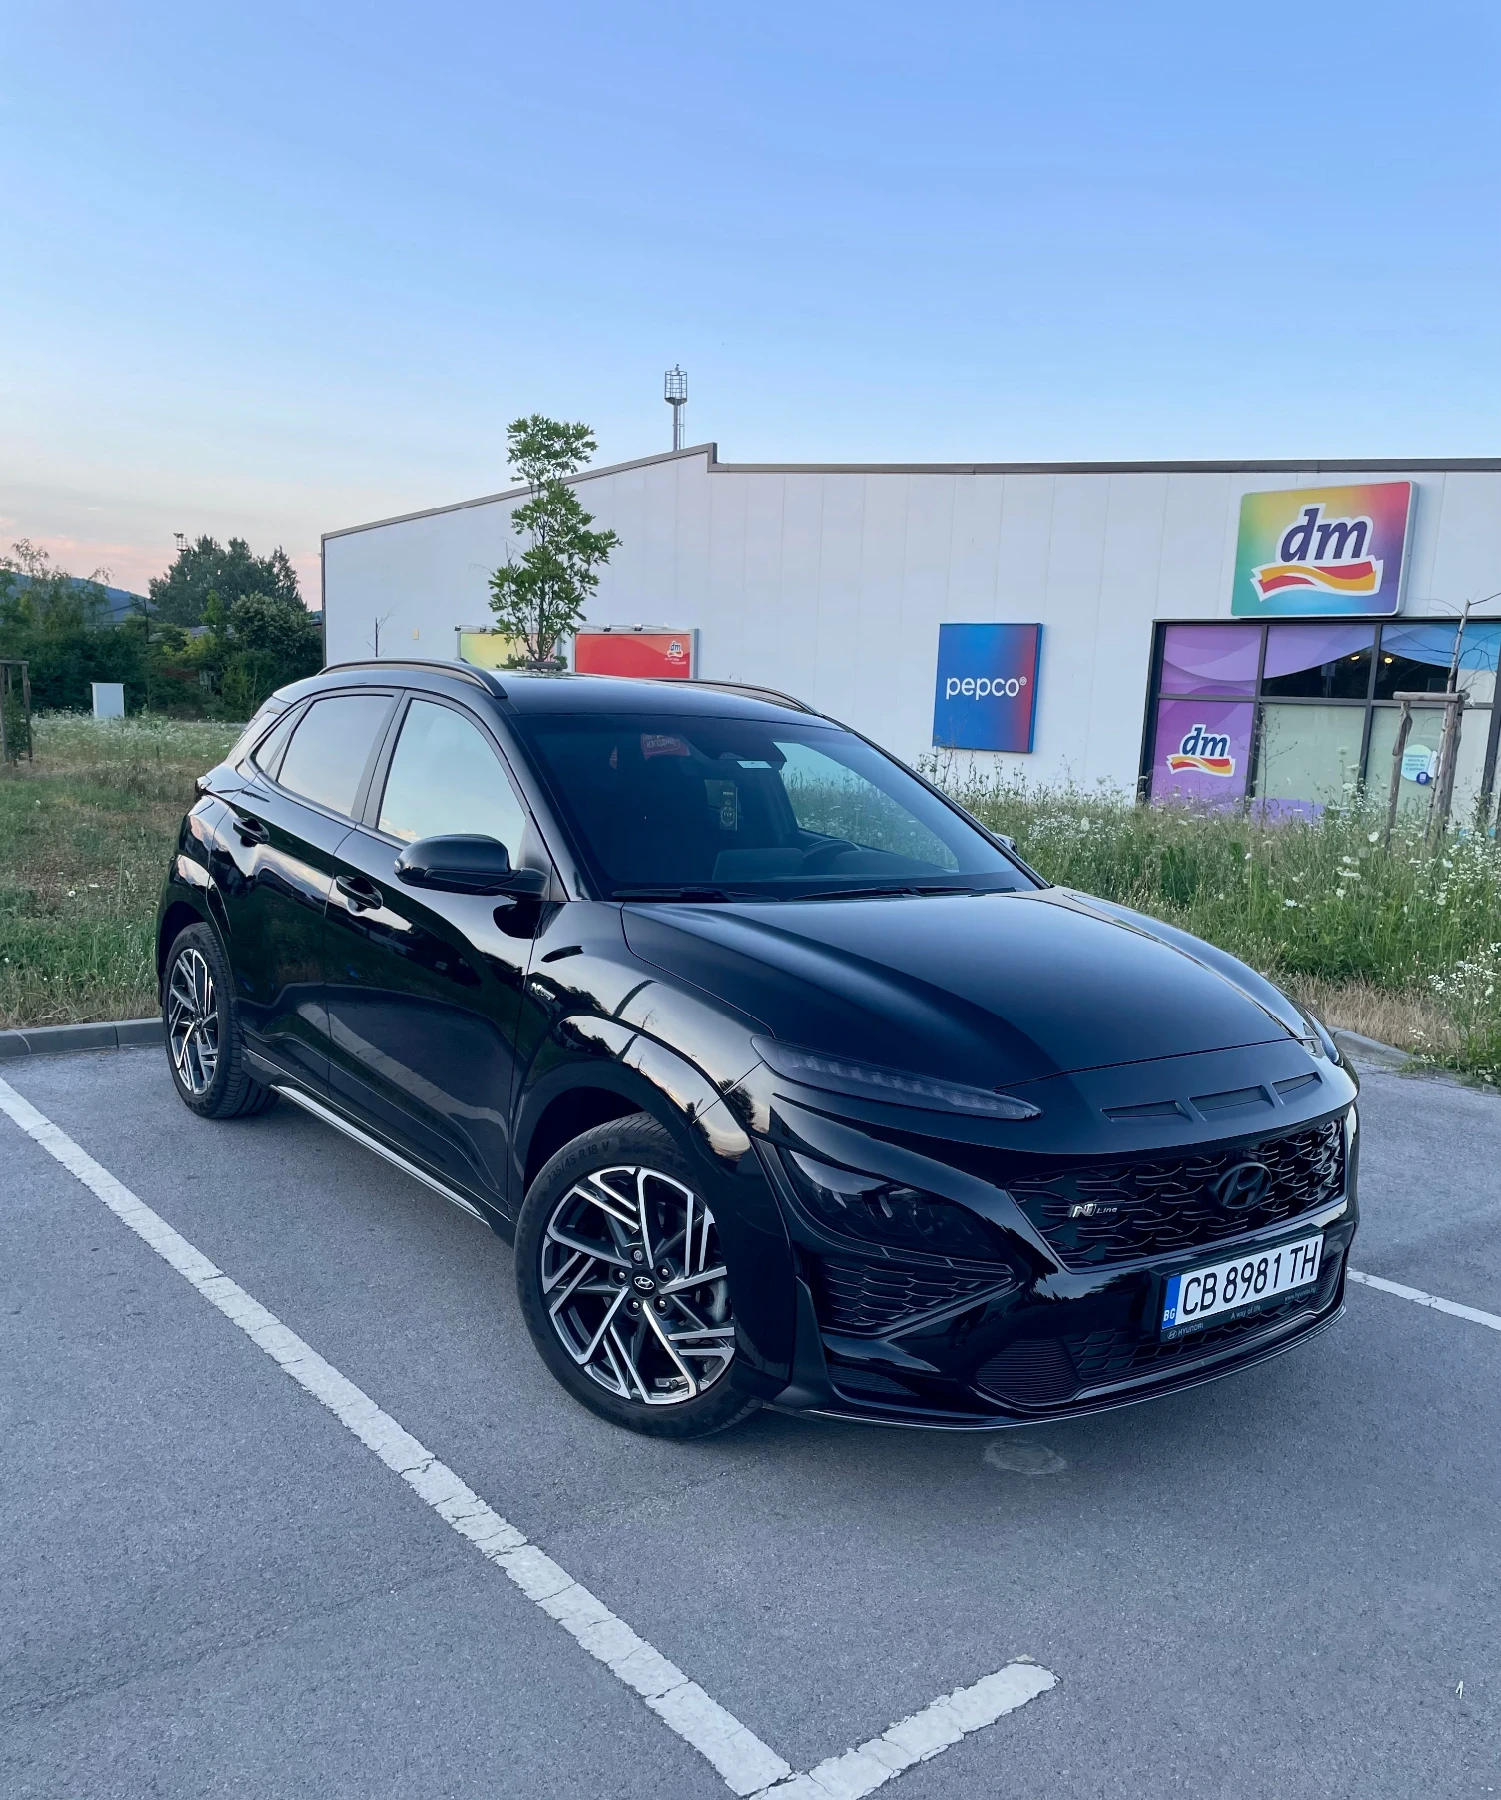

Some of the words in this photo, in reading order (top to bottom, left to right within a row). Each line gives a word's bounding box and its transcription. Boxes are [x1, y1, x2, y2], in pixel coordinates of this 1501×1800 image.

[1280, 507, 1368, 563] dm
[1181, 726, 1229, 757] dm
[1182, 1272, 1218, 1316] CB
[1222, 1252, 1282, 1304] 8981
[1290, 1241, 1319, 1284] TH
[1163, 1308, 1176, 1322] BG
[1230, 1312, 1236, 1320] A
[1236, 1310, 1246, 1319] way
[1178, 1323, 1204, 1336] HYUNDAI
